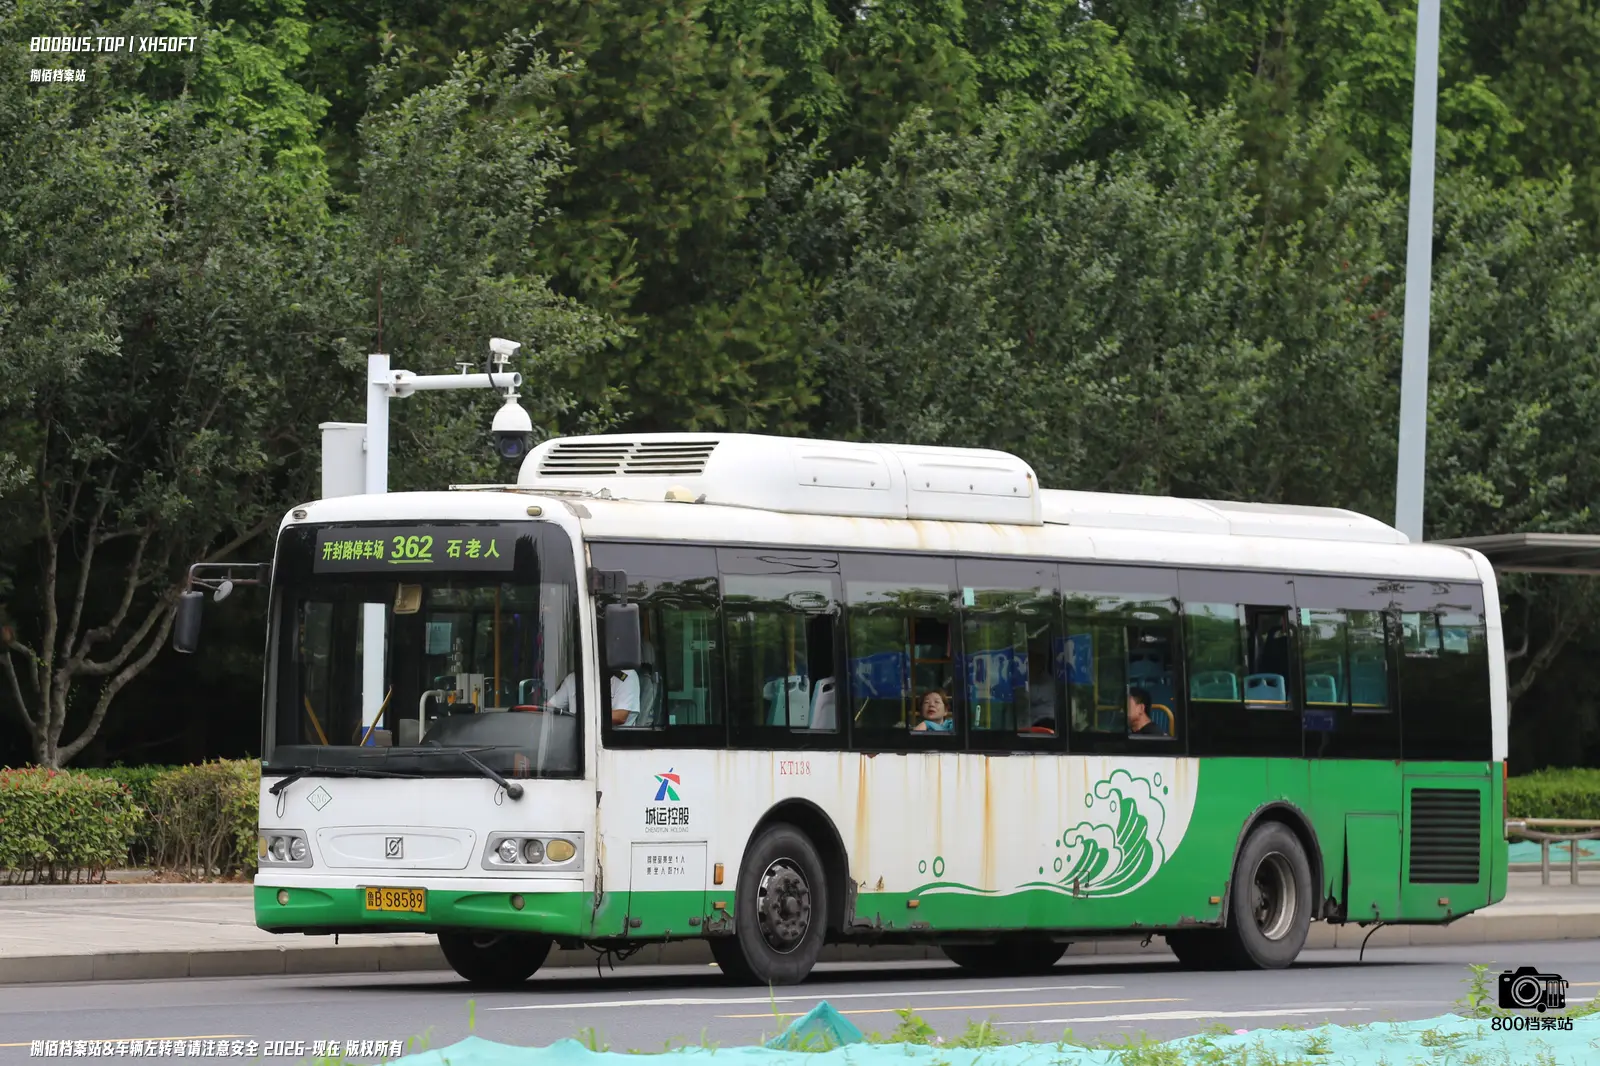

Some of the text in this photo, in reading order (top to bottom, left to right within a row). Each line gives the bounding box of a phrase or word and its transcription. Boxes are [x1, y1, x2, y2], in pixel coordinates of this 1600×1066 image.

[322, 535, 500, 560] 开封路停车场 362 石老人
[780, 761, 811, 776] KT138
[645, 807, 689, 825] 城运控股
